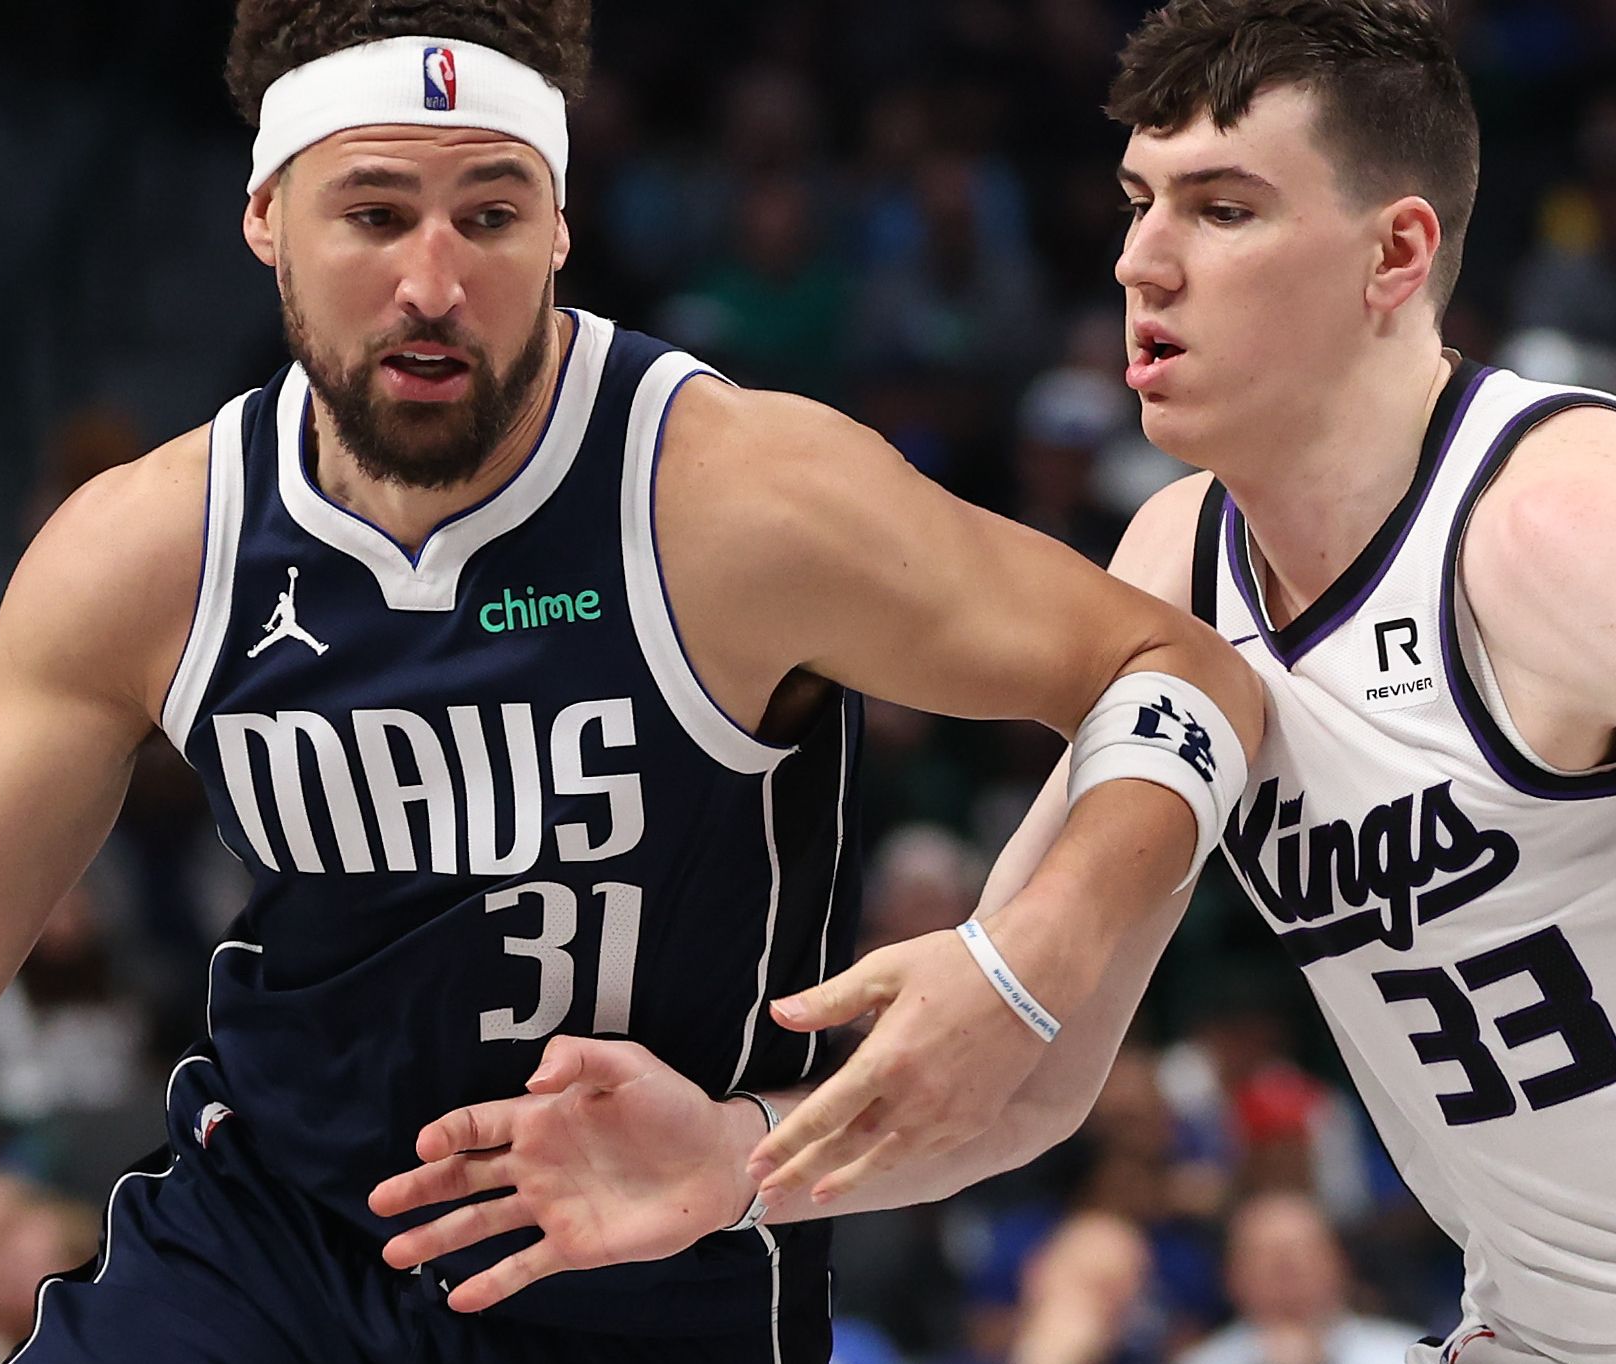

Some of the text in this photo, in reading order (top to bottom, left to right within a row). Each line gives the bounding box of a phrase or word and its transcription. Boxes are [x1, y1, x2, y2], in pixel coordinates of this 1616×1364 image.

[479, 585, 601, 633] chime
[1366, 677, 1433, 701] REVIVER
[212, 697, 644, 876] MAVS
[1222, 776, 1520, 955] Kings
[480, 881, 643, 1042] 31
